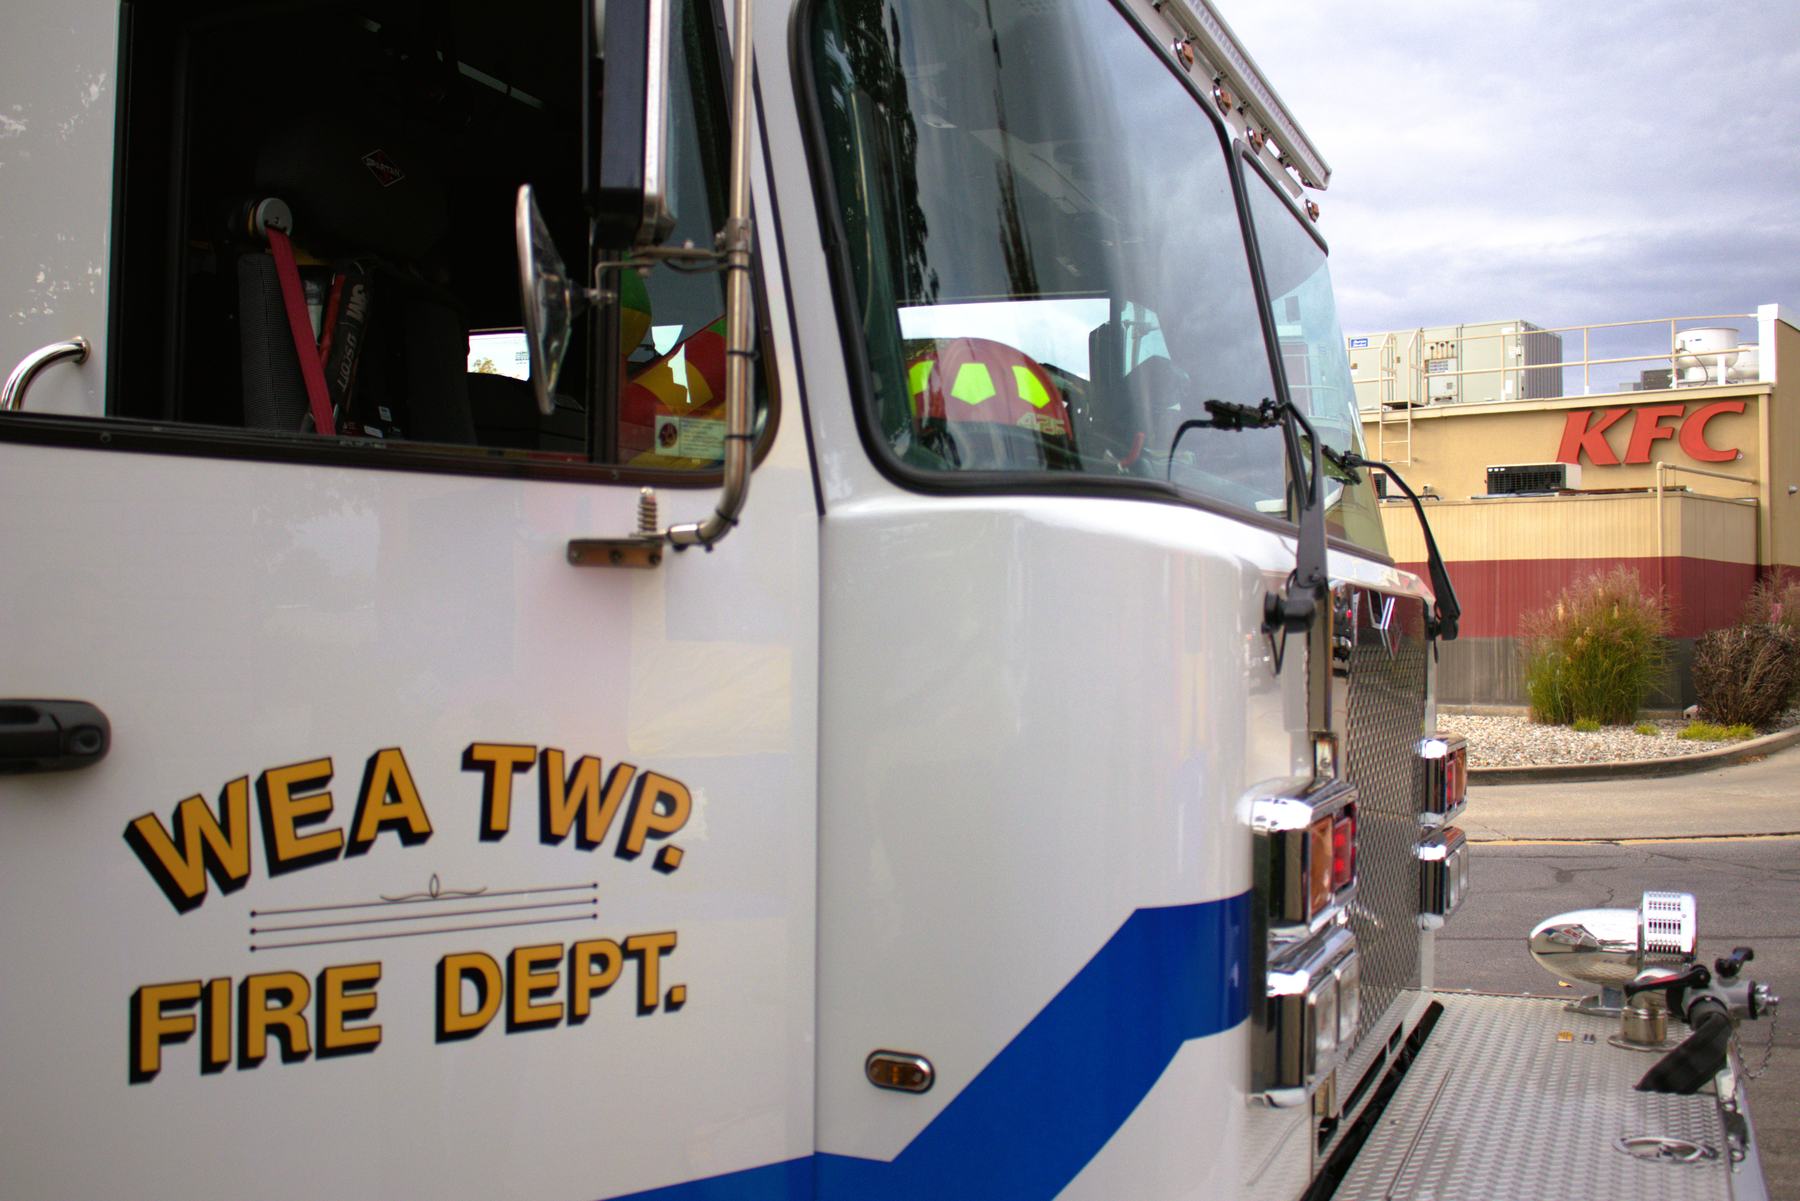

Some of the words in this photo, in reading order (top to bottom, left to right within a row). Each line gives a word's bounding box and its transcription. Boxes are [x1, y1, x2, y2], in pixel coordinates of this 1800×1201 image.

[1556, 401, 1746, 466] KFC
[123, 747, 433, 915] WEA
[461, 742, 692, 874] TWP.
[129, 962, 382, 1085] FIRE
[435, 931, 687, 1044] DEPT.
